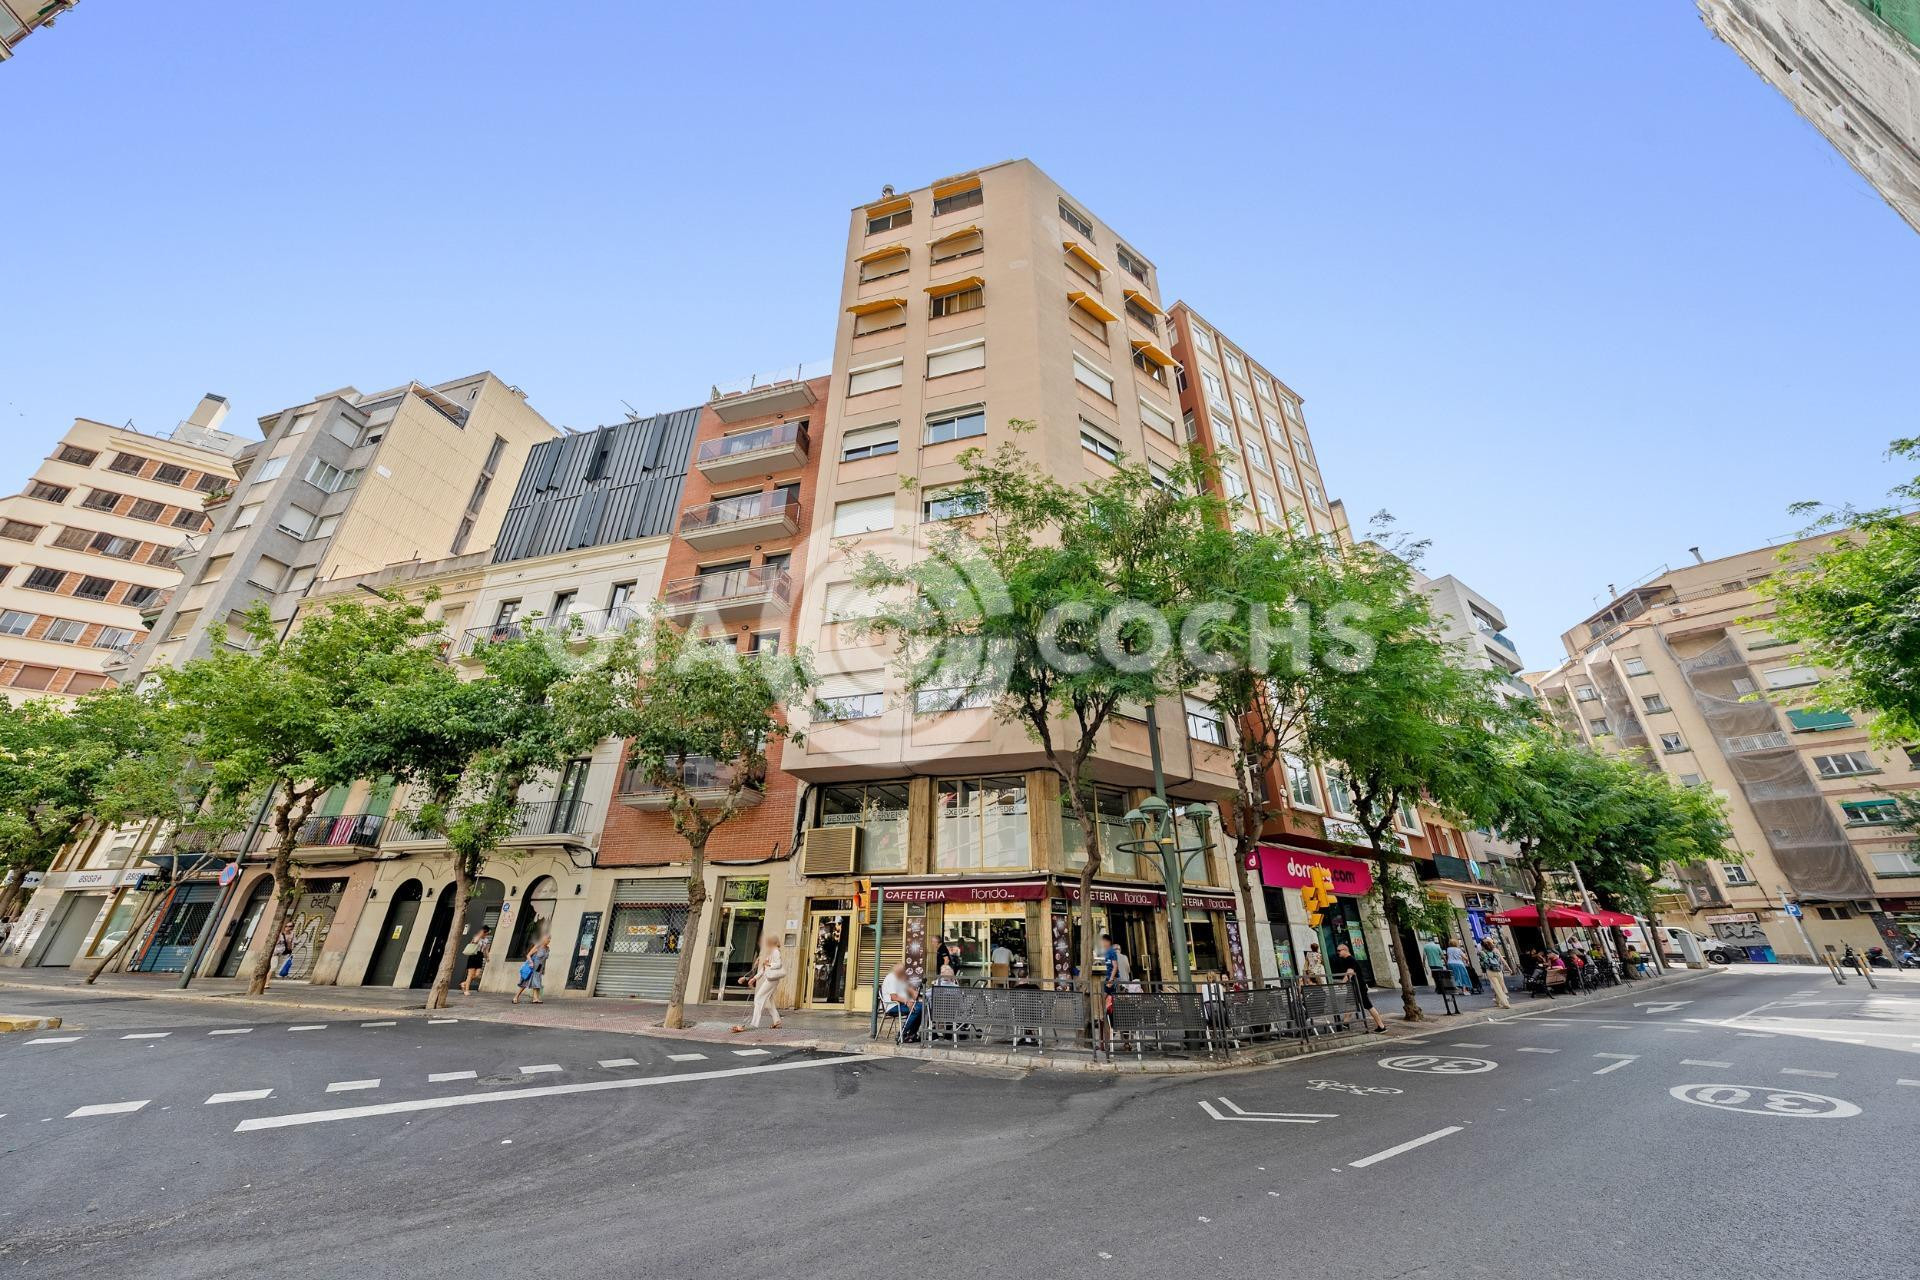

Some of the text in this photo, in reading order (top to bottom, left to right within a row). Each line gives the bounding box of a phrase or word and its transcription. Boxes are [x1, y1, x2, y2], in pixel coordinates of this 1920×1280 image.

[827, 814, 861, 822] GESTIONS
[885, 890, 945, 900] CAFETERIA
[1073, 889, 1118, 902] CETERIA
[1788, 905, 1797, 914] P
[1697, 1086, 1819, 1114] 30
